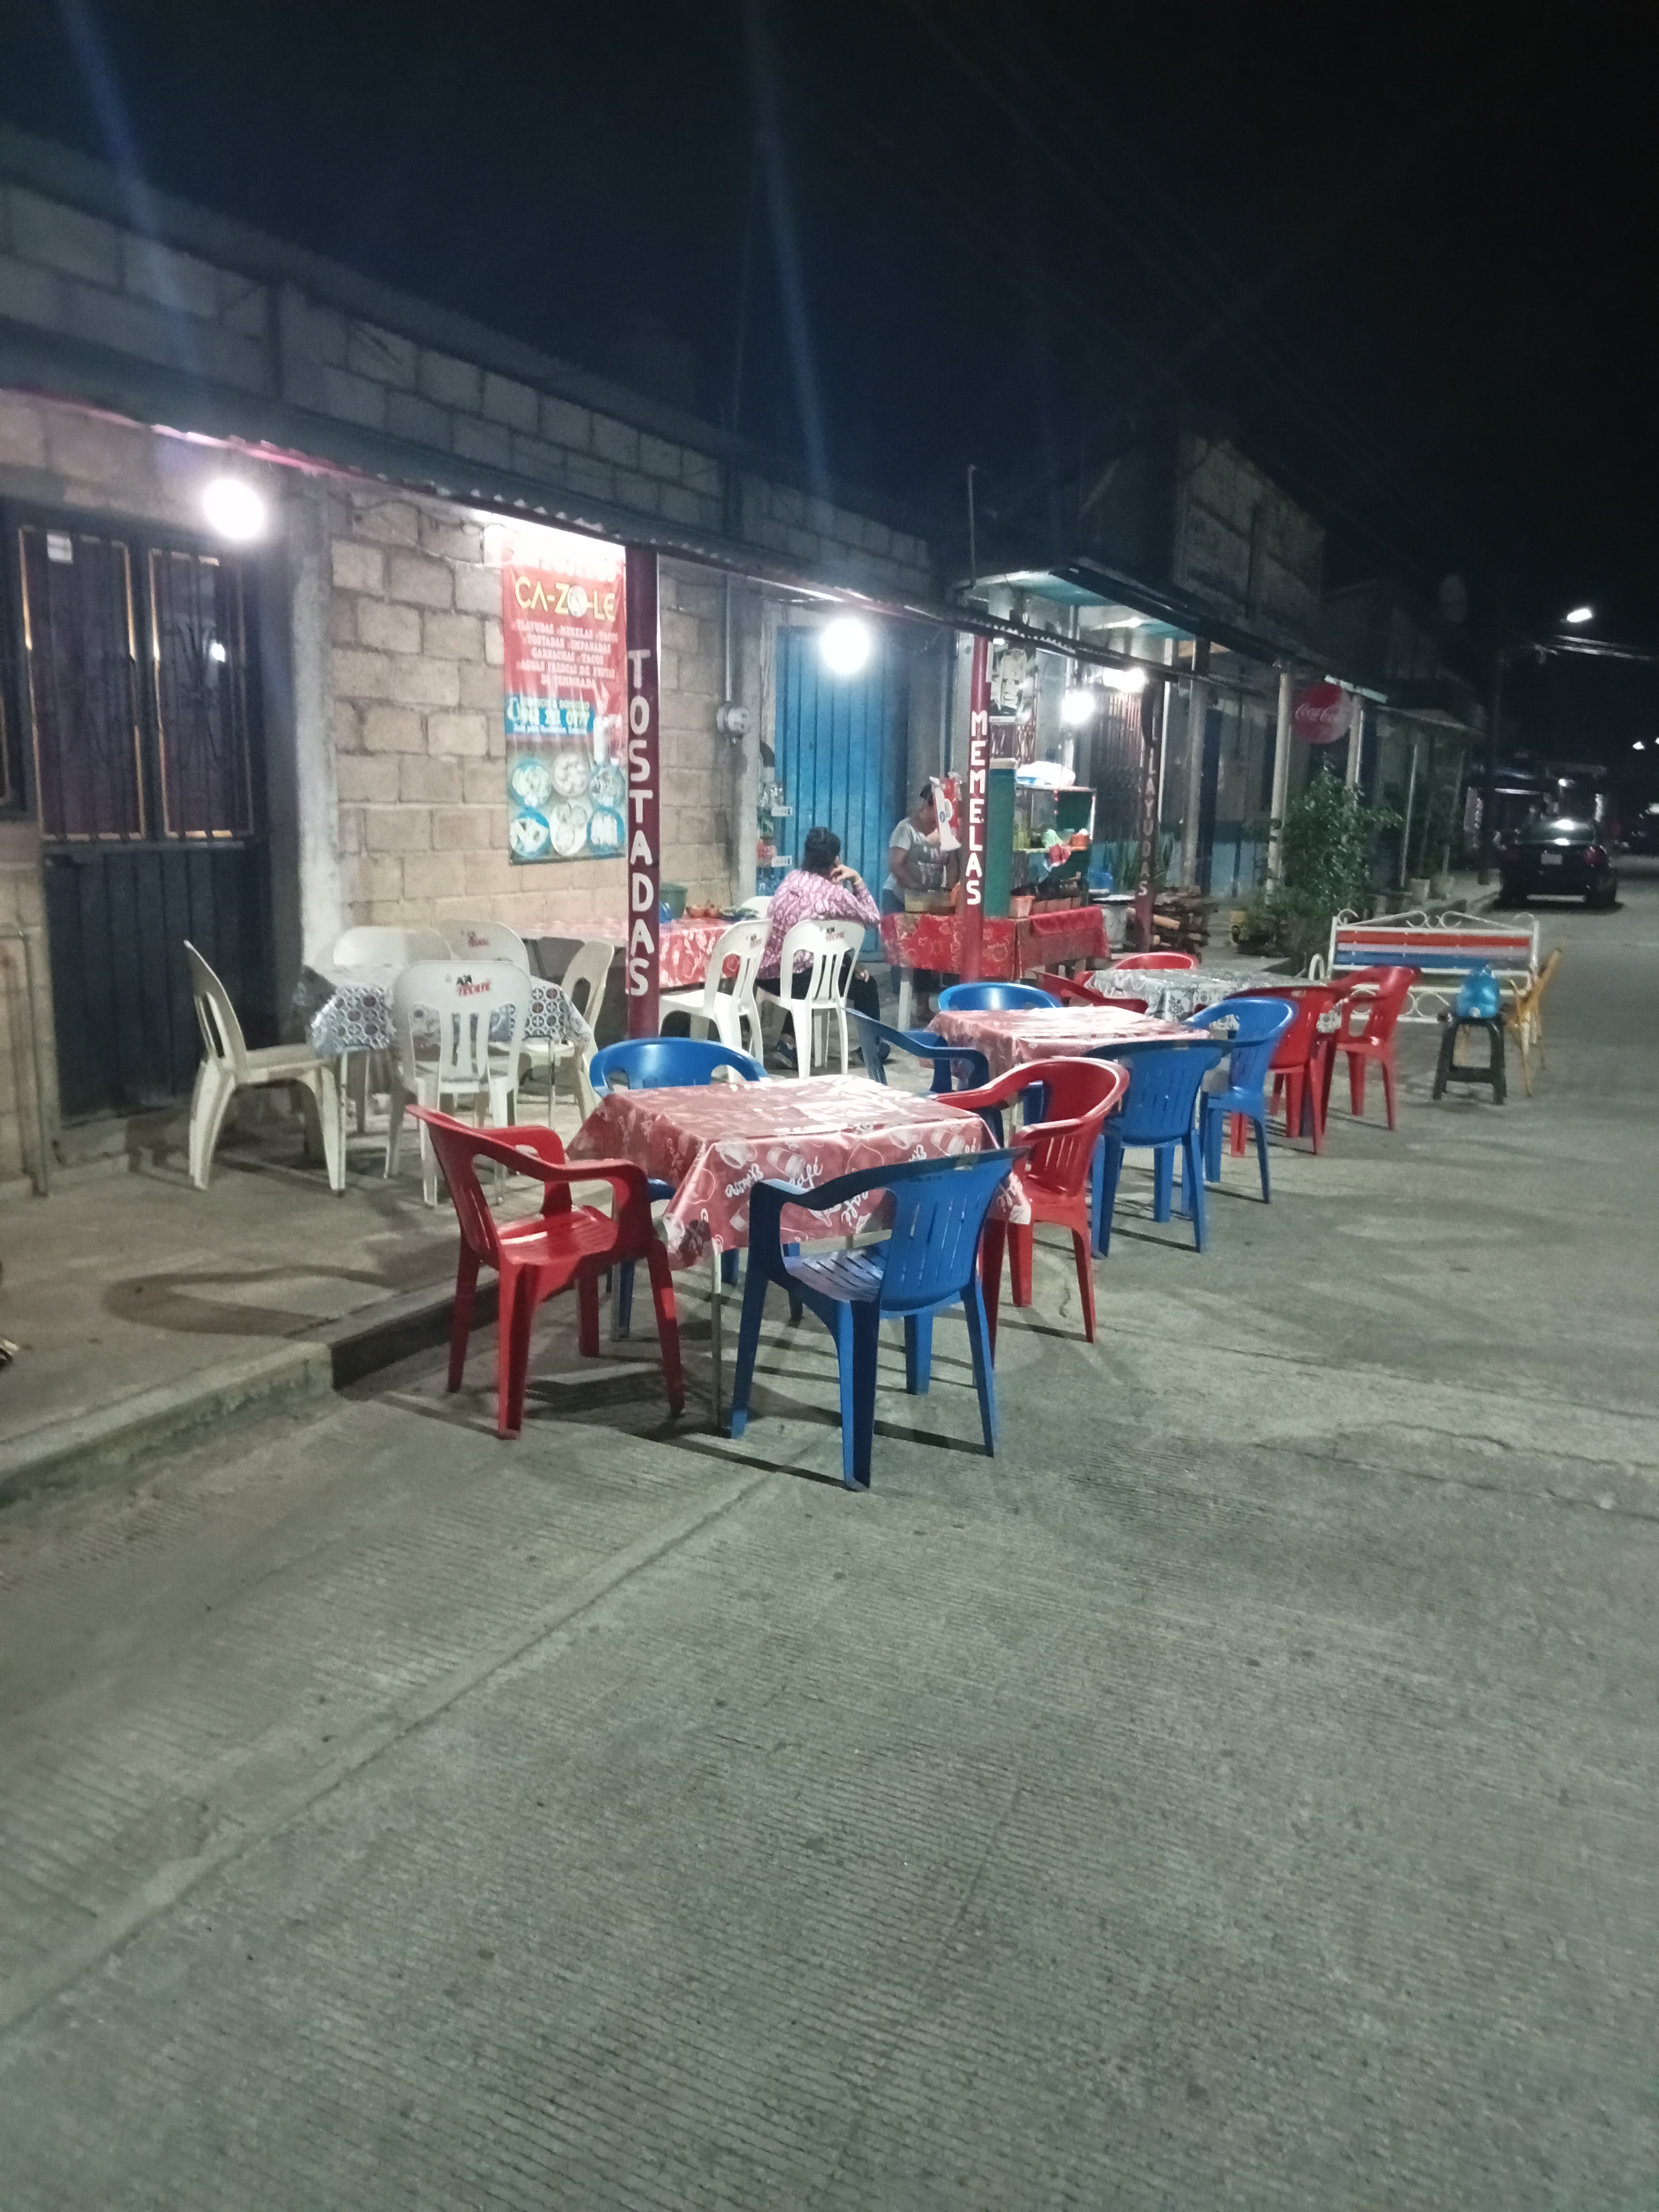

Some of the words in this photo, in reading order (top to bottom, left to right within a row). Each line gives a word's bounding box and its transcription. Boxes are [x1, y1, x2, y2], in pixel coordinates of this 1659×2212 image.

[516, 619, 554, 634] TLAYUDAS
[560, 625, 593, 639] MEMELAS
[599, 631, 618, 642] TACOS
[527, 633, 564, 648] TOSTADAS
[571, 639, 611, 653] EMPANADAS
[531, 647, 575, 661] GARNACHAS
[581, 653, 604, 665] TACOS
[521, 659, 544, 671] AGUAS
[548, 662, 577, 675] FRESCAS
[580, 665, 590, 676] DE
[593, 667, 615, 679] FRUTAS
[553, 675, 596, 689] TEMPORADA
[967, 710, 987, 904] MEMELAS
[628, 650, 654, 996] TOSTADAS
